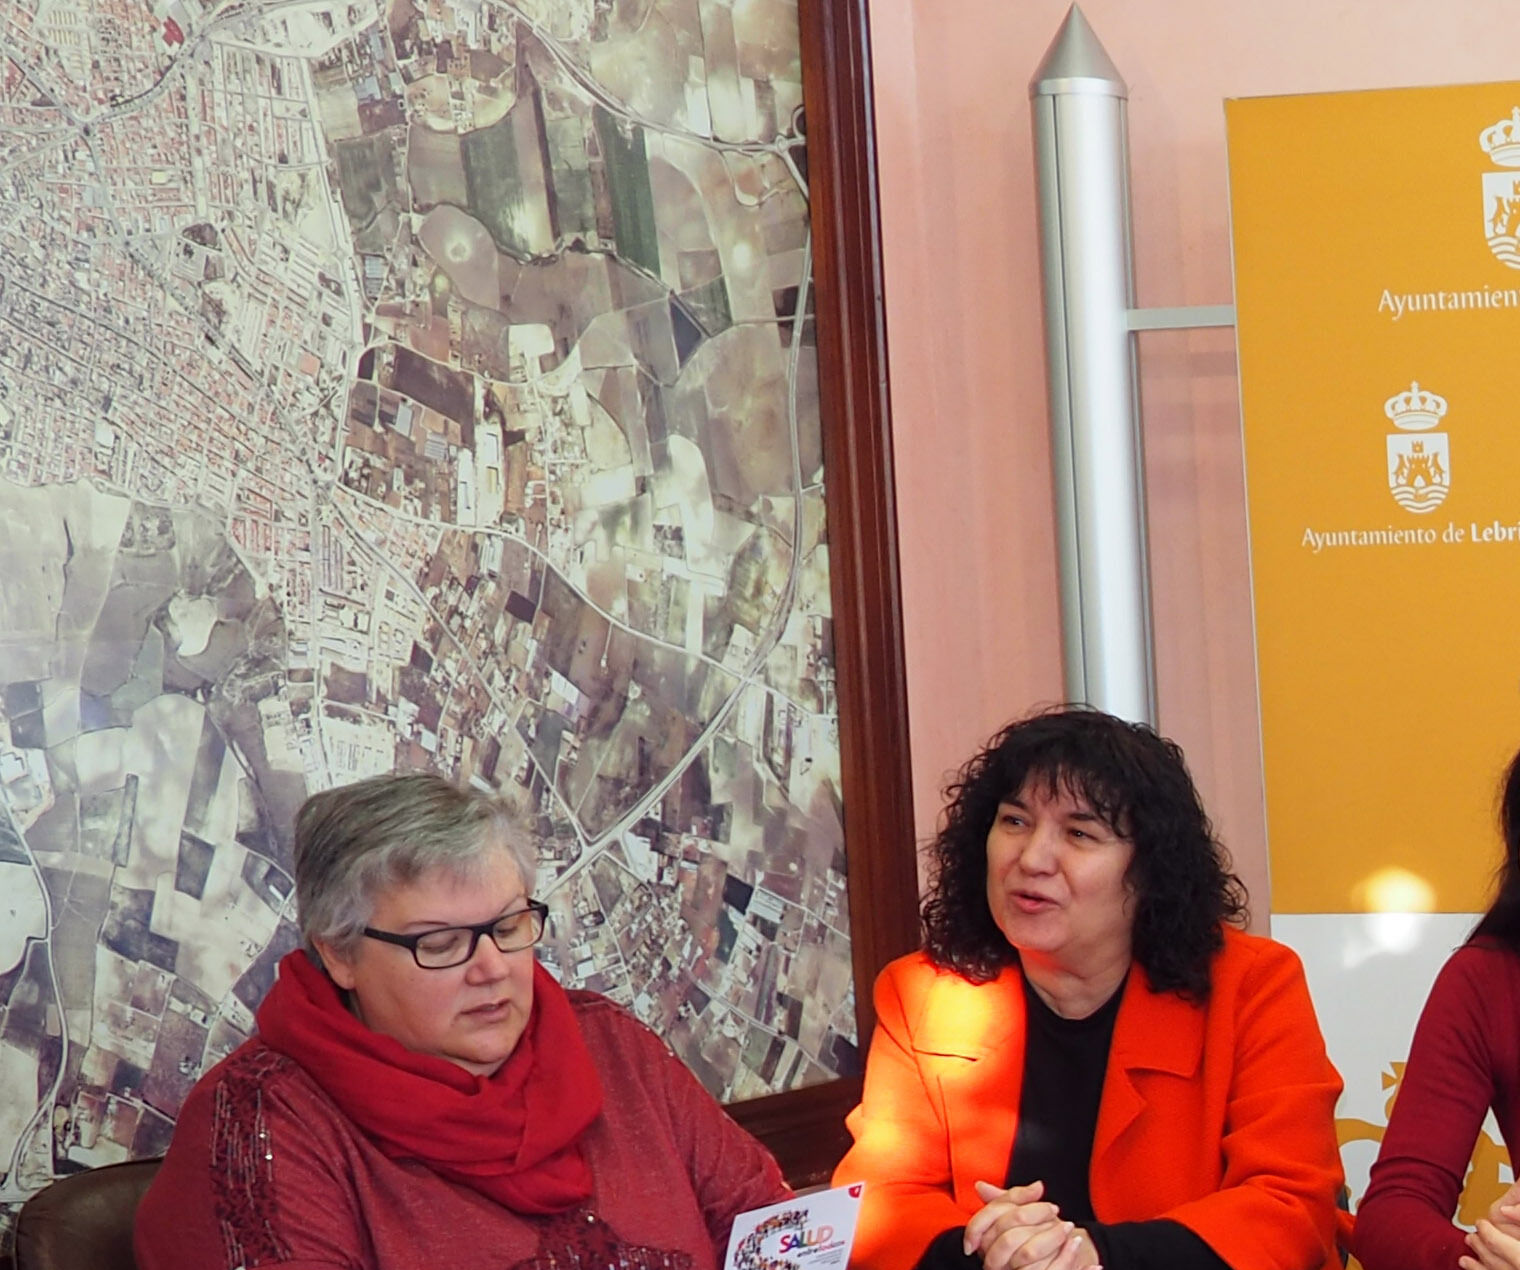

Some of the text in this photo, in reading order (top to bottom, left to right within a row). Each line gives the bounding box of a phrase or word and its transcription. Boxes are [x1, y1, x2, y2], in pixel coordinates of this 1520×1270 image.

[1302, 525, 1437, 550] Ayuntamiento
[1442, 522, 1465, 543] de
[779, 1225, 834, 1254] SALUD
